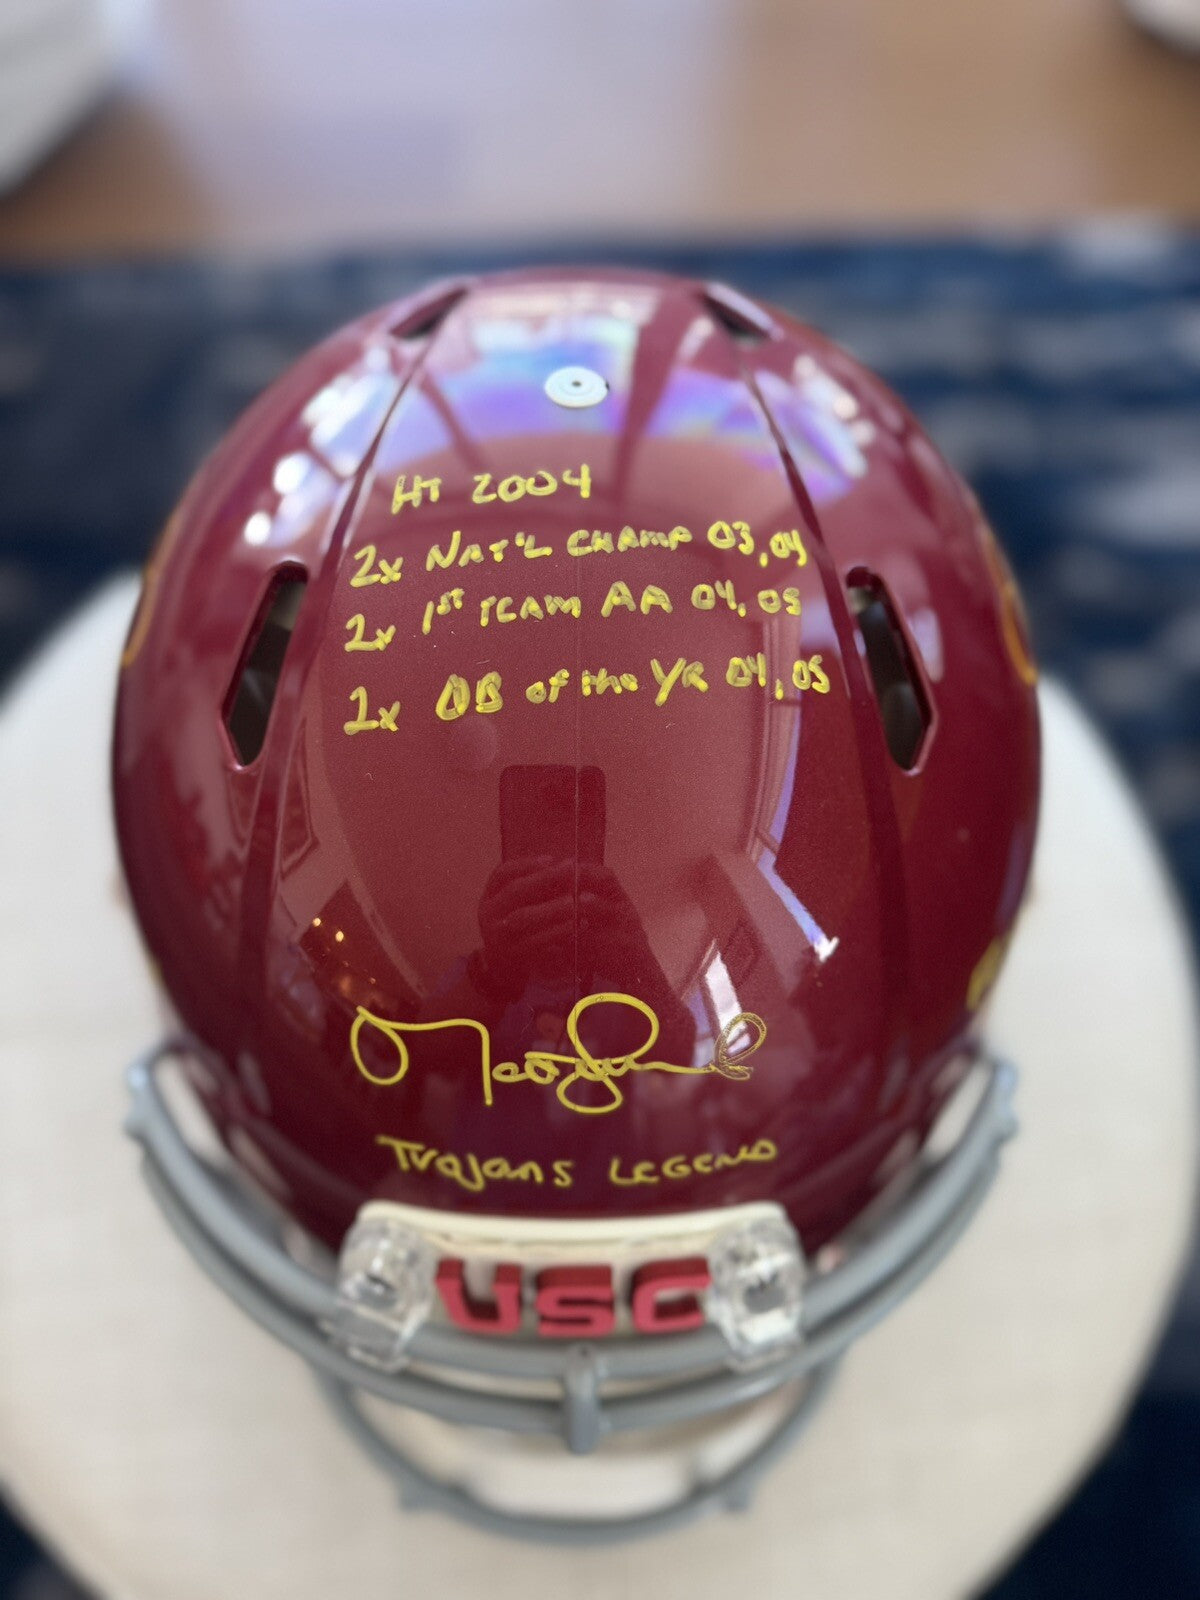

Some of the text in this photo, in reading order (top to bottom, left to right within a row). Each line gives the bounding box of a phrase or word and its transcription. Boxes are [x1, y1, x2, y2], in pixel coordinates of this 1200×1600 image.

[472, 463, 592, 504] 2004
[600, 580, 673, 617] AA
[434, 1257, 711, 1338] USC
